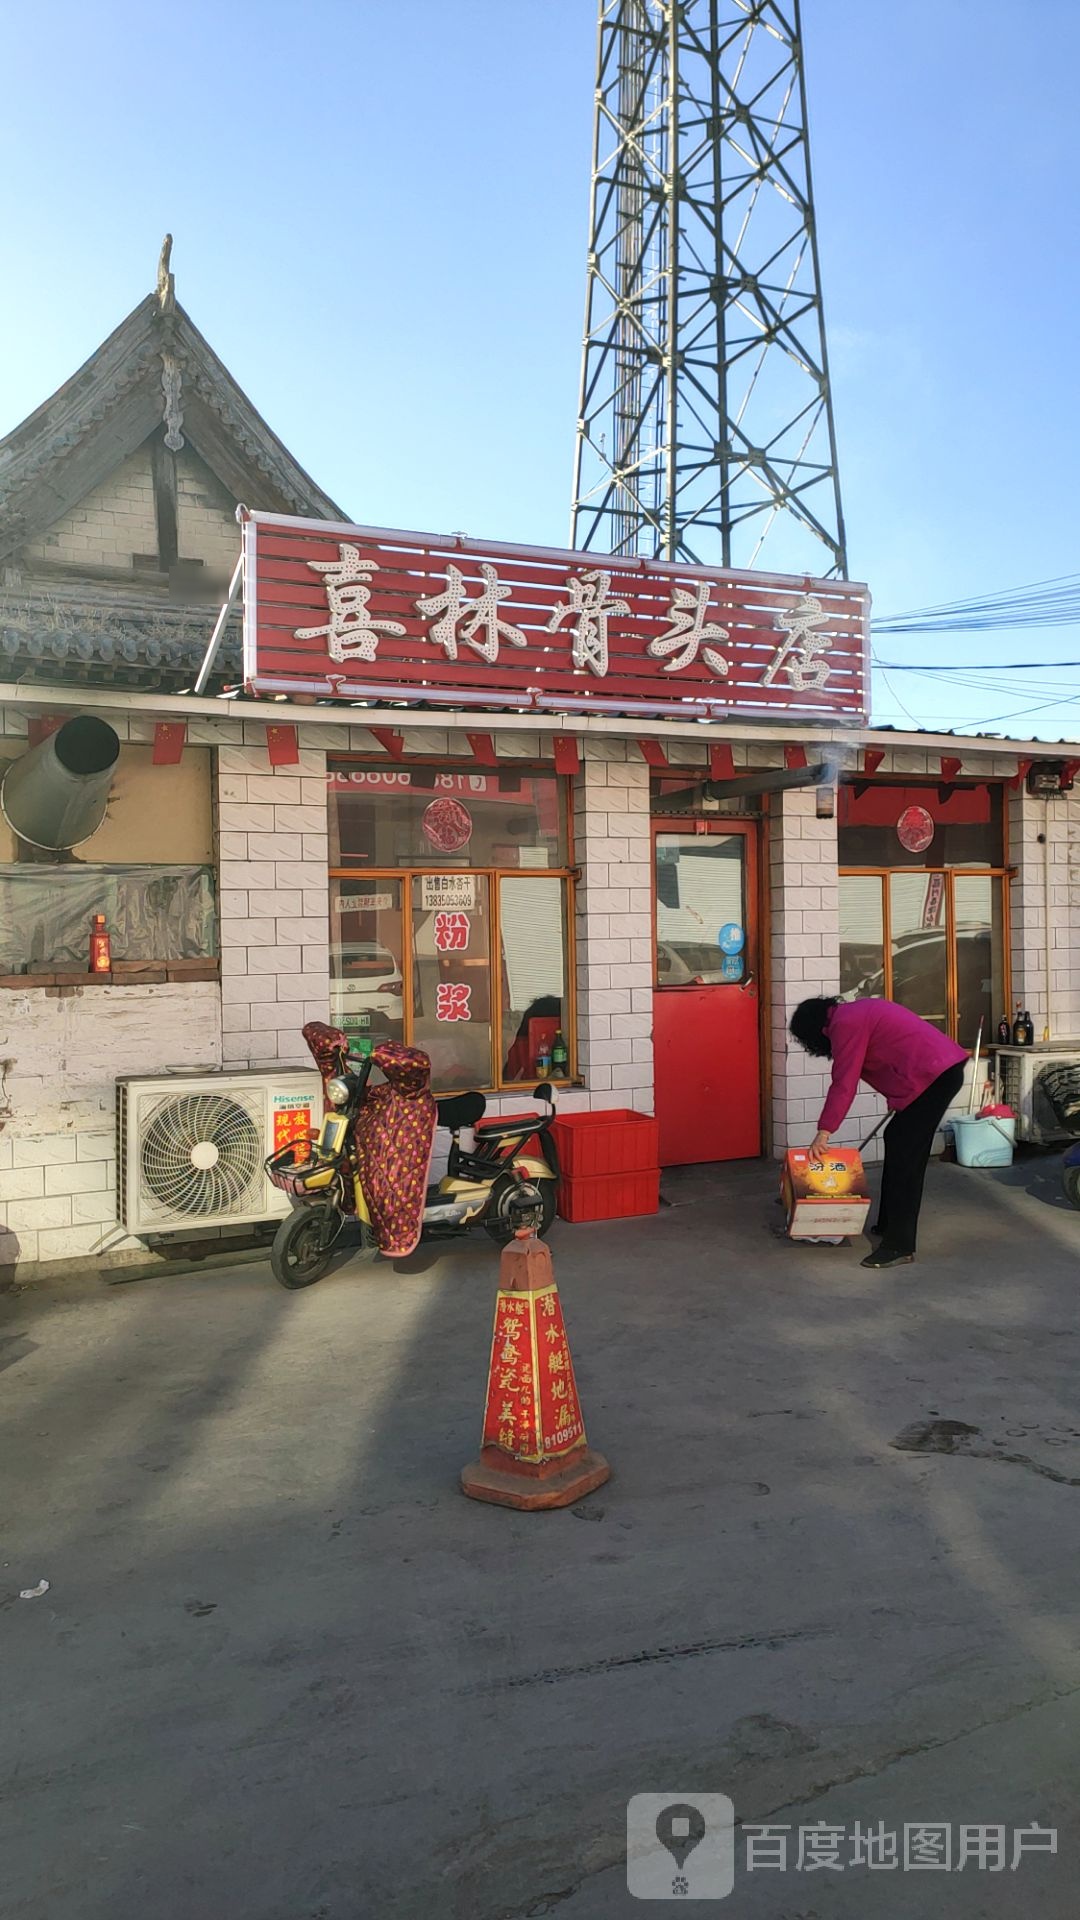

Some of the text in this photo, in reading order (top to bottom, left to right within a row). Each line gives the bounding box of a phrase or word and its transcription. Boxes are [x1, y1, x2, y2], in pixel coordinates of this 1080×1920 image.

[293, 542, 834, 693] 喜林骨头店
[274, 1095, 315, 1103] Hisense
